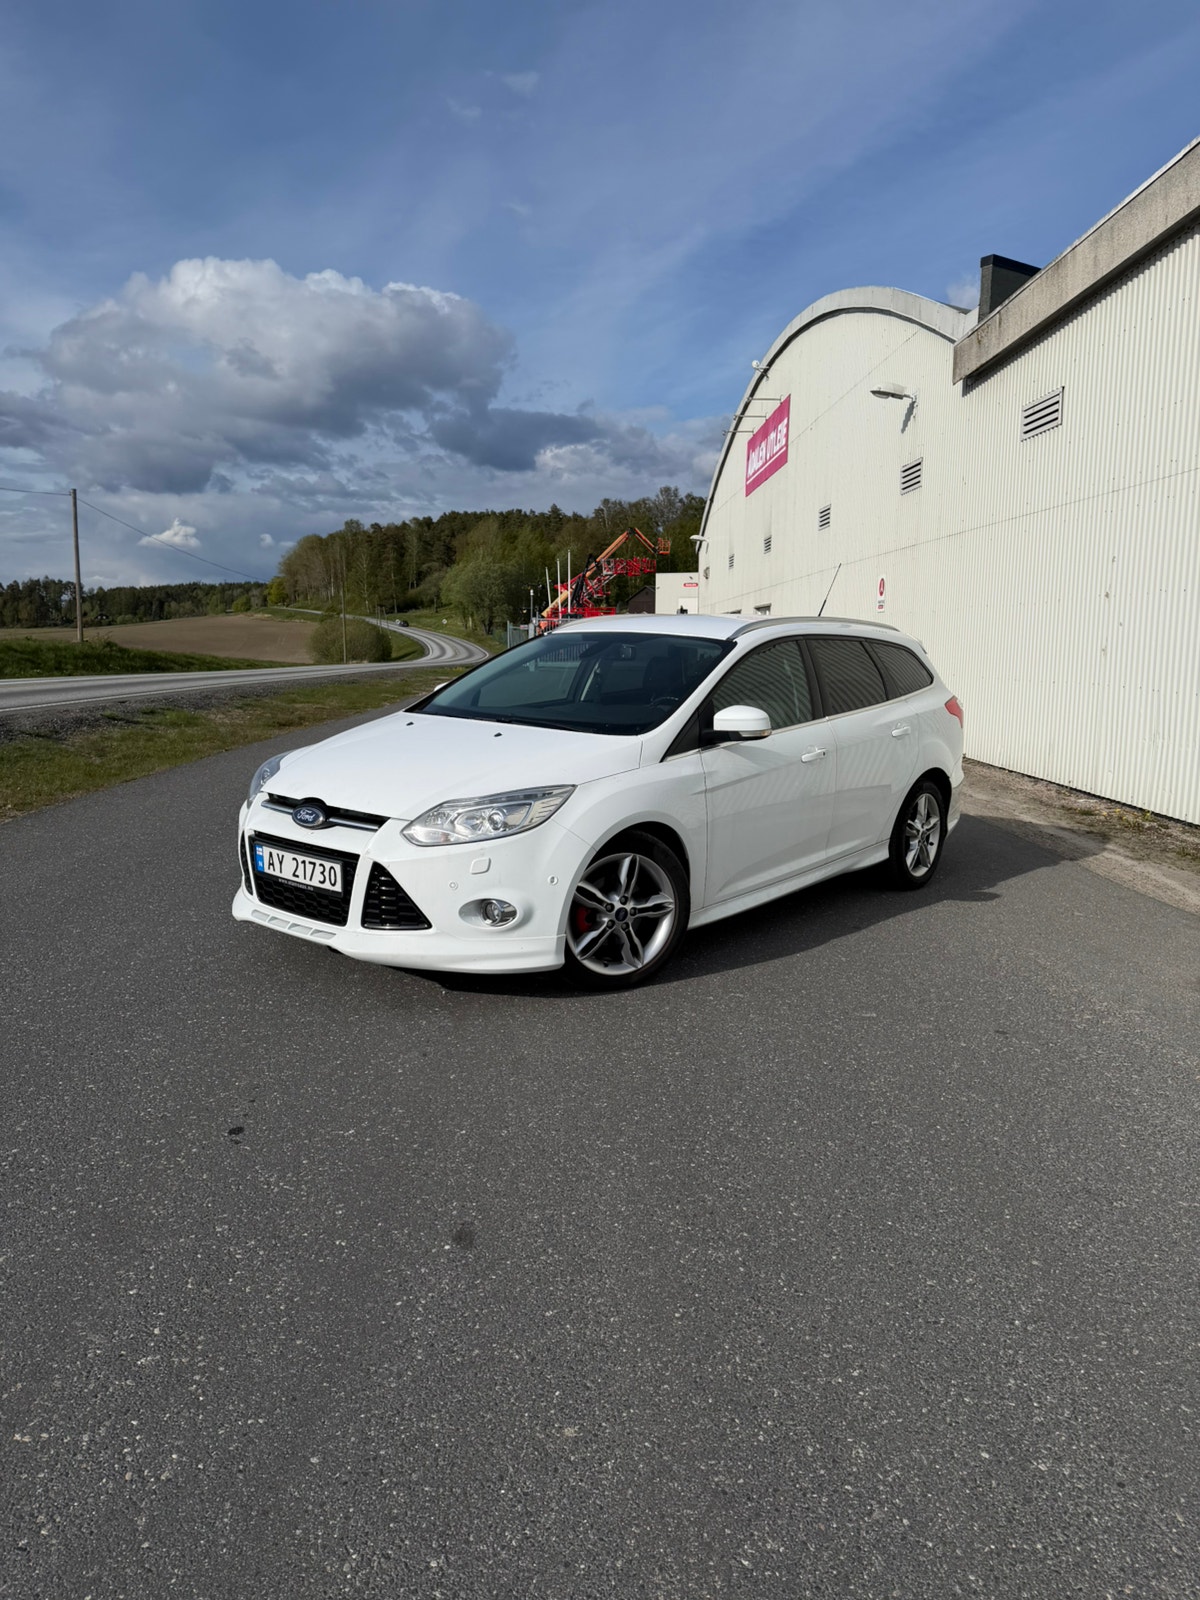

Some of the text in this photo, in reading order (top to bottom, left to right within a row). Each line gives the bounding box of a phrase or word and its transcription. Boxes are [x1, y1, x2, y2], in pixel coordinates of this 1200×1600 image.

[767, 417, 788, 461] UTLEIE
[297, 809, 316, 821] Ford
[268, 851, 337, 887] AY 21730
